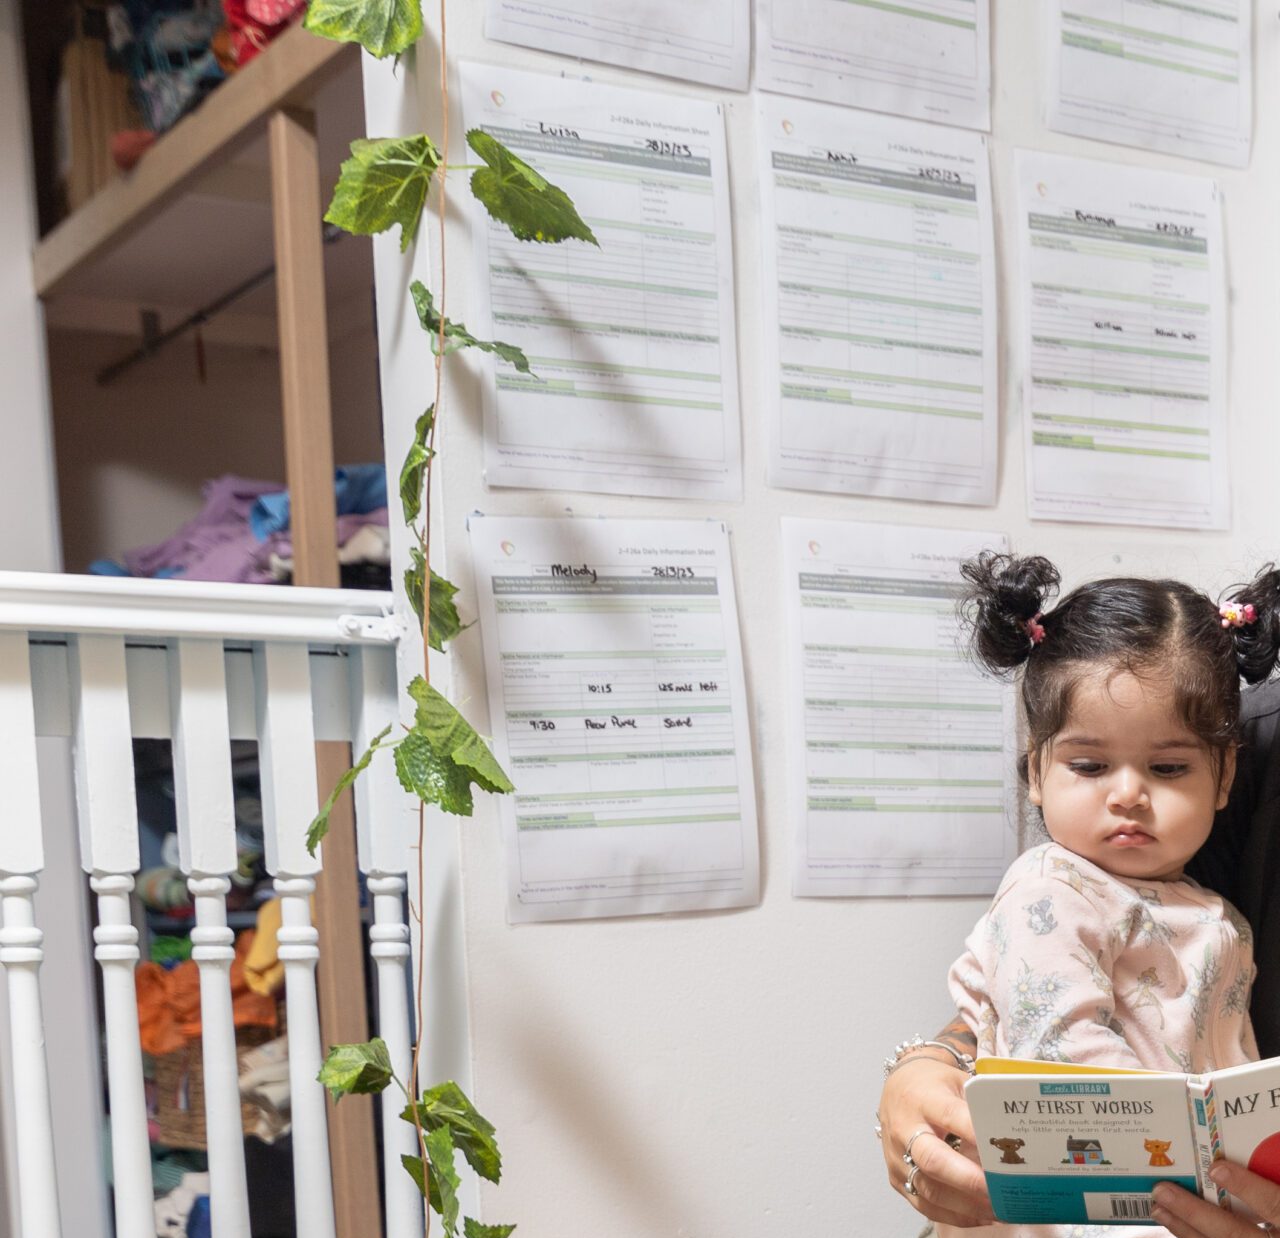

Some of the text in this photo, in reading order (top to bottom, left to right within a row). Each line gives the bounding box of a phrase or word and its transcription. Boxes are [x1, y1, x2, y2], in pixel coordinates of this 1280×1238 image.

[539, 122, 581, 141] Luisa
[551, 564, 597, 583] Melody
[587, 684, 612, 694] 10:15
[1071, 1083, 1108, 1094] LIBRARY
[1003, 1099, 1155, 1115] MY FIRST WORDS
[1223, 1092, 1260, 1119] MY
